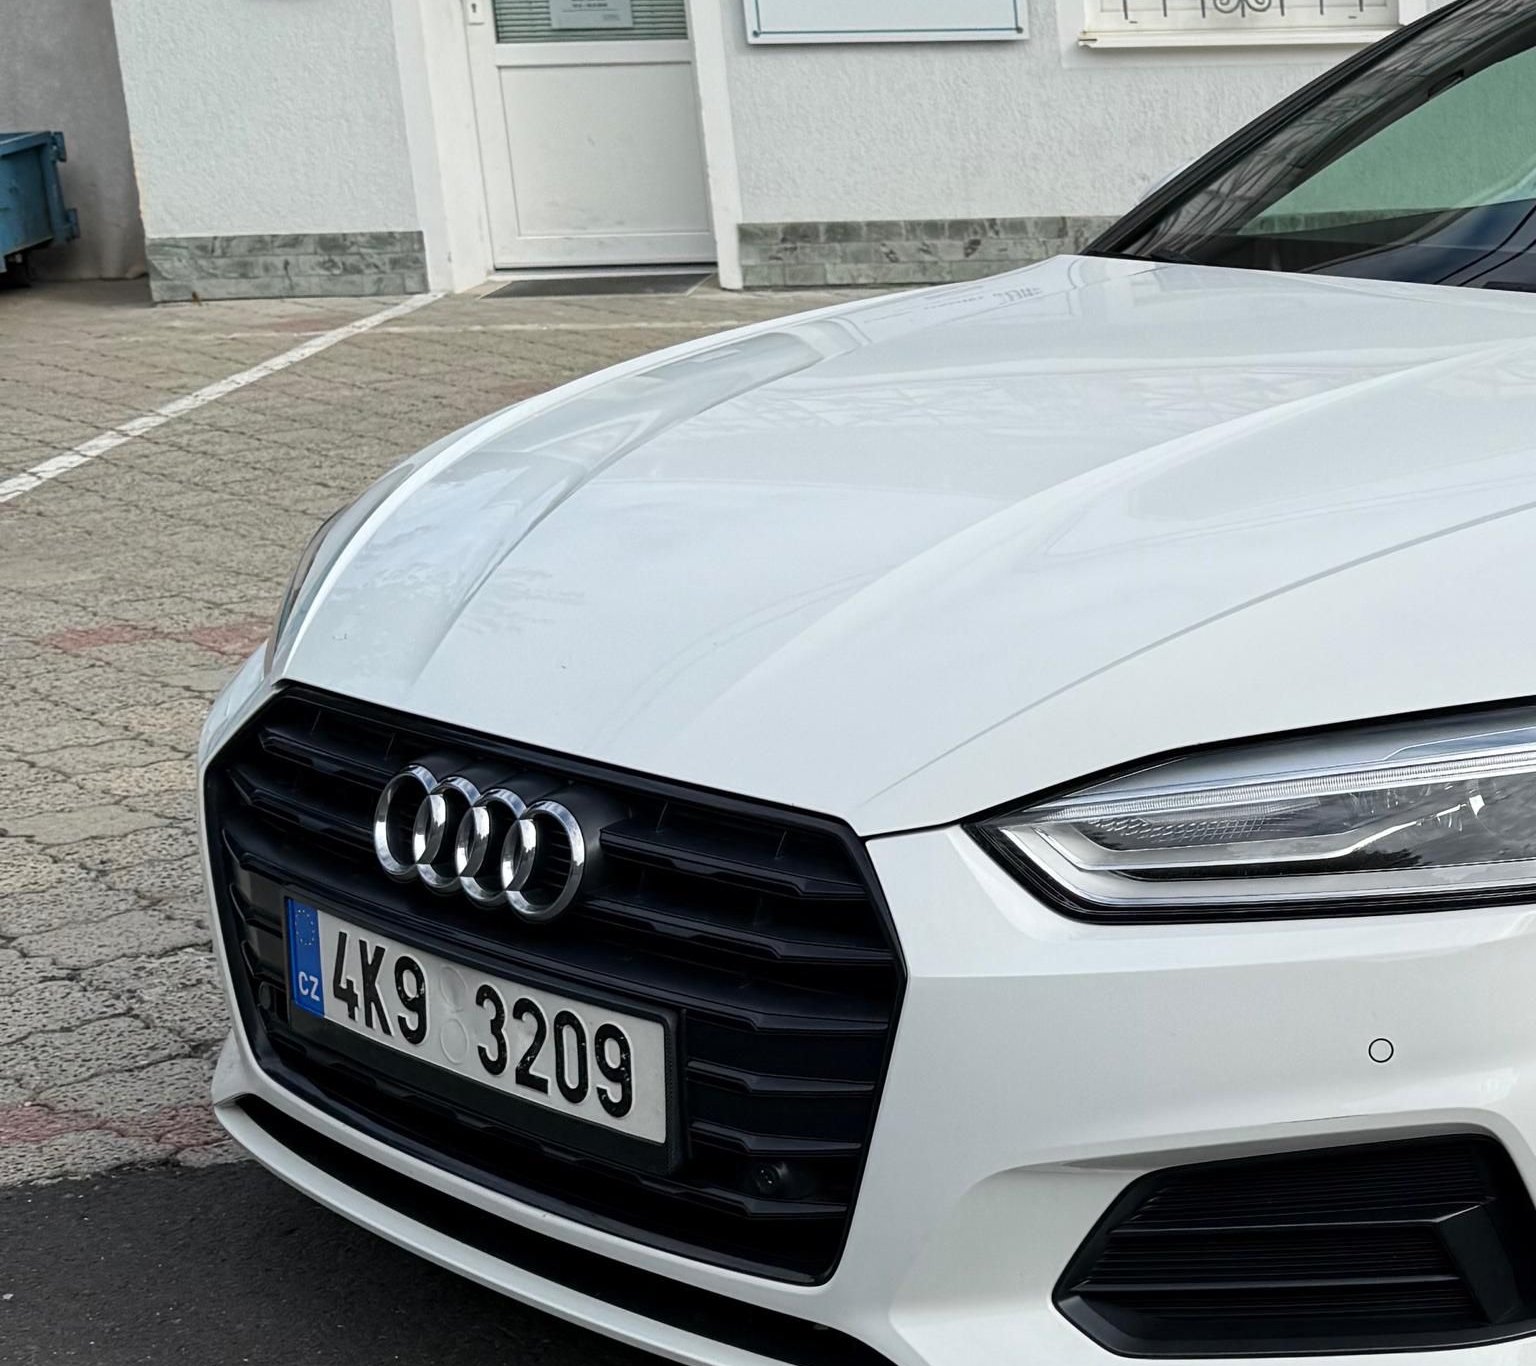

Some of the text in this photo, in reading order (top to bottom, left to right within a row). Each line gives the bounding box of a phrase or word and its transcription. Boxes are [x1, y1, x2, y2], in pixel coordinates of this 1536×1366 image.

[298, 970, 321, 1002] CZ
[331, 930, 634, 1119] 4K9 3209
